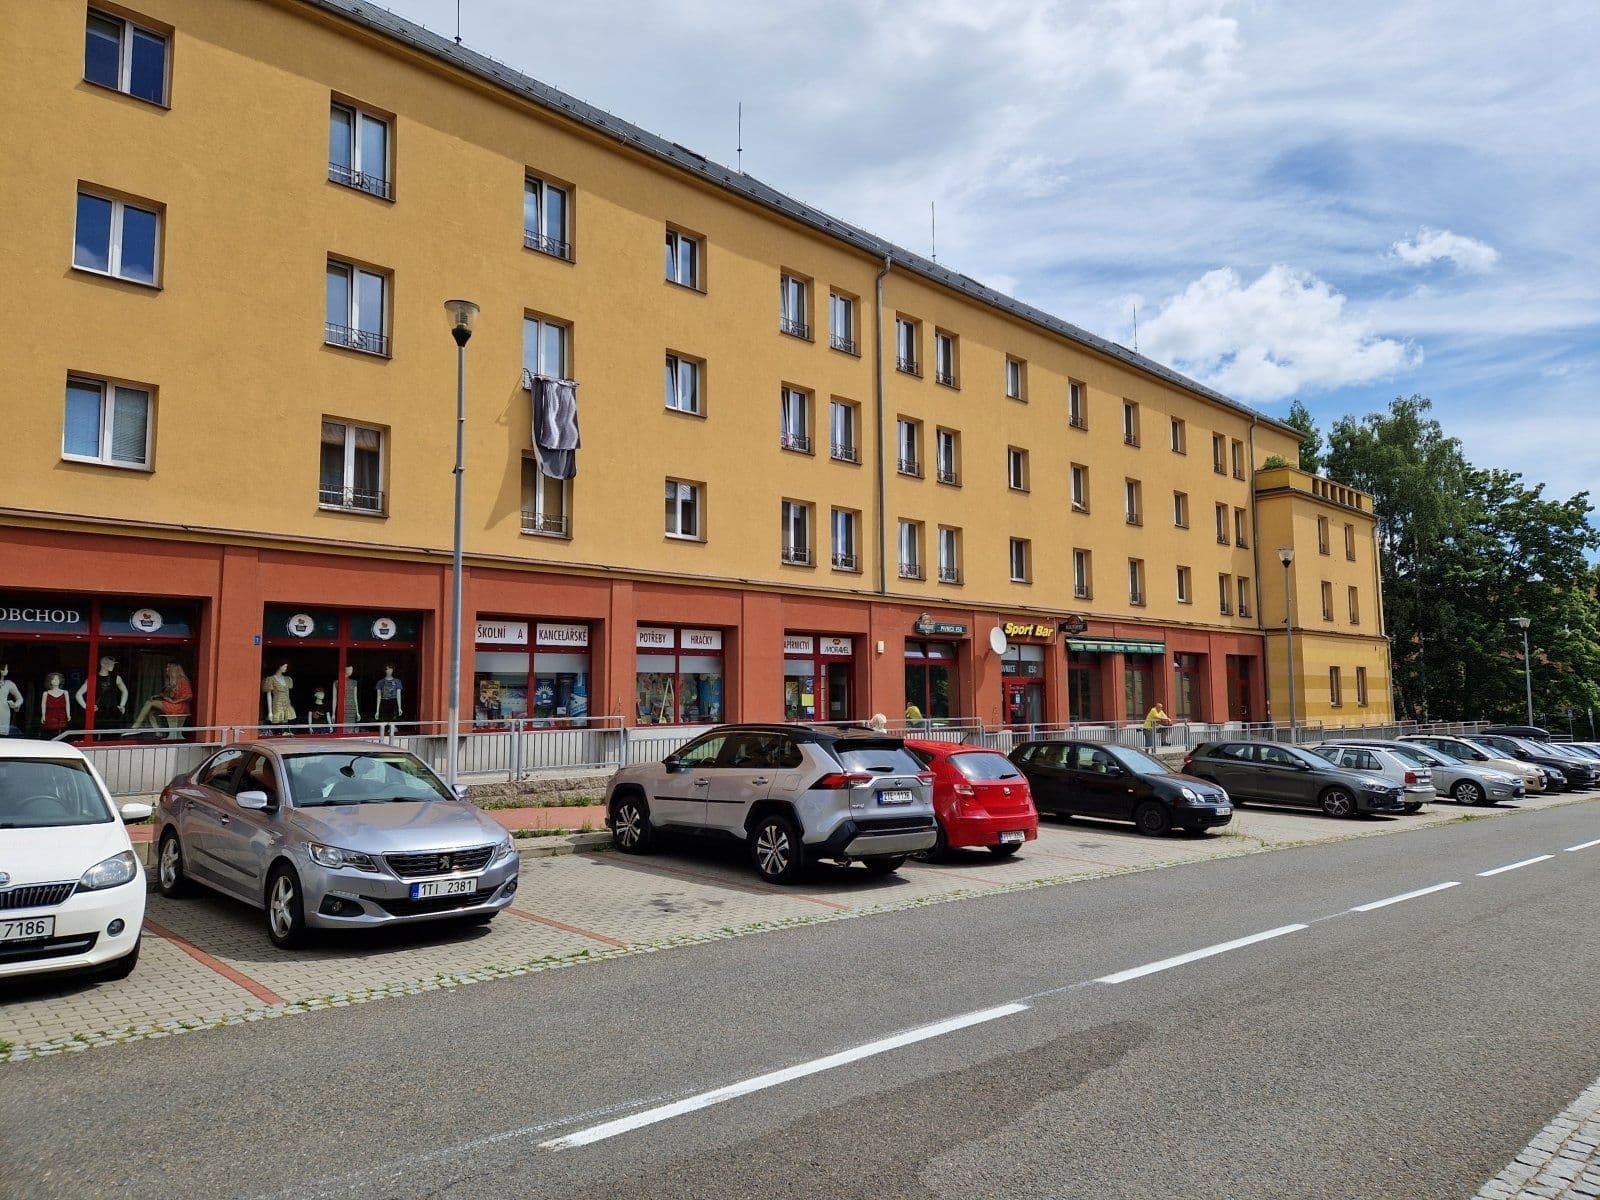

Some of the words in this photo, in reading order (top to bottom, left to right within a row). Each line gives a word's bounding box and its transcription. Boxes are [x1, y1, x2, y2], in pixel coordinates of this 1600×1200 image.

[0, 607, 80, 623] OBCHOD
[477, 623, 507, 638] ŠKOLNÍ
[517, 629, 524, 639] A
[538, 627, 587, 641] KANCELÁŘSKÉ
[639, 630, 667, 644] POTŘEBY
[690, 633, 713, 645] HRAČKY
[1005, 622, 1034, 637] Sport
[1035, 625, 1054, 637] Bar
[421, 883, 439, 897] 1TI
[447, 880, 472, 894] 2381
[4, 920, 46, 938] 7186
